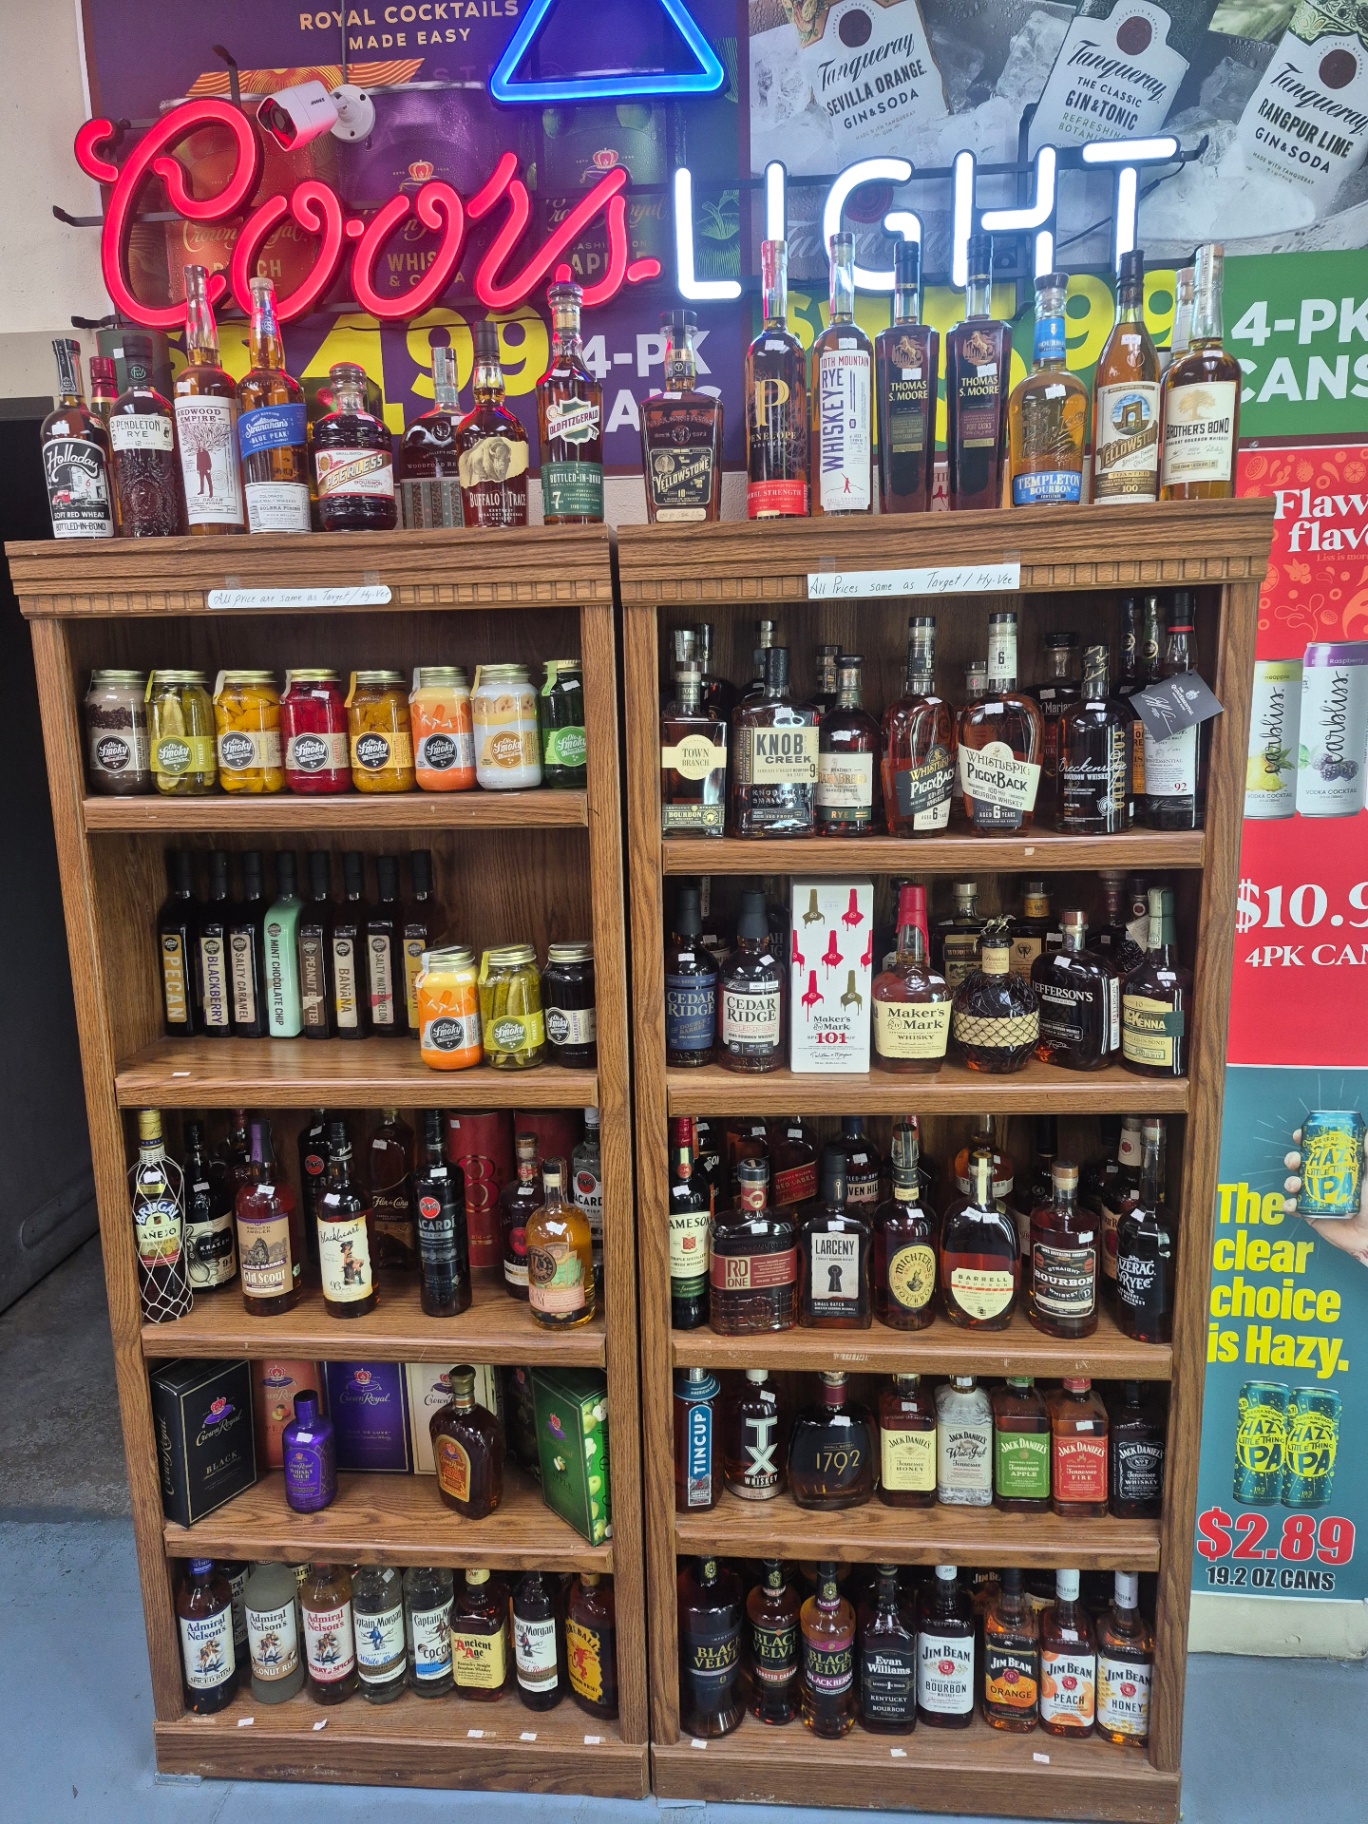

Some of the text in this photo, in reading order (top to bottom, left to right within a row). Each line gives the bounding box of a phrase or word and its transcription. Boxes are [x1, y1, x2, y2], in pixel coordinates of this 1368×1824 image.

[300, 0, 519, 30] ROYAL COCKTAILS
[349, 28, 471, 50] MADE EASY
[817, 34, 914, 91] Tanqueray
[826, 82, 874, 117] SEVILLA
[1078, 76, 1142, 108] THE CLASSIC
[843, 88, 919, 129] GIN&SODA
[1065, 90, 1138, 131] GIN&TONIC
[1258, 98, 1354, 159] RANGPUR LIME
[1255, 127, 1330, 174] GIN&SODA
[74, 97, 1180, 328] Coors LIGHT
[838, 356, 869, 368] MOUNTAIN
[822, 368, 844, 389] RYE
[891, 380, 927, 392] THOMAS
[961, 375, 998, 386] THOMAS
[889, 390, 928, 402] S. MOORE
[959, 385, 999, 397] S. MOORE
[117, 420, 160, 431] PENDLETON
[245, 419, 288, 438] Stranahan's
[550, 410, 598, 435] OLD FITZGERALD
[1166, 418, 1229, 440] BROTHER'S BOND
[251, 435, 266, 443] BLUE
[822, 390, 845, 474] WHISKEY
[46, 444, 98, 483] Holladay
[327, 454, 382, 488] PEERLESS
[652, 458, 710, 494] YELLOWSTONE
[1018, 474, 1080, 489] TEMPLETON
[1030, 485, 1071, 494] BOURBON
[1122, 484, 1138, 492] 100
[470, 491, 526, 507] BUFFALO TRACE
[1287, 520, 1368, 552] flav
[810, 577, 826, 595] All
[832, 575, 858, 594] Prices
[870, 583, 892, 591] same
[903, 581, 914, 590] as
[927, 571, 962, 591] Target
[280, 594, 301, 603] same
[323, 590, 350, 603] Target
[682, 748, 709, 758] TOWN
[756, 733, 804, 756] KNOB
[682, 759, 709, 767] BRANCH
[765, 756, 811, 764] CREEK
[1245, 946, 1305, 967] 4PK
[270, 939, 284, 1026] MINT CHOCOLATE CHIP
[305, 956, 317, 994] PEANUT
[164, 956, 184, 1020] PECAN
[207, 956, 223, 1024] BLACKBERRY
[338, 968, 352, 1013] BANANA
[1032, 980, 1094, 1002] JEFFERSON'S
[236, 980, 249, 1020] CARAMEL
[727, 996, 776, 1010] CEDAR
[727, 1008, 776, 1022] RIDGE
[888, 1007, 945, 1018] Maker's
[433, 1026, 461, 1038] Smoky
[903, 1019, 944, 1030] Mark
[815, 1032, 848, 1044] 101
[1217, 1182, 1285, 1225] The
[136, 1201, 179, 1225] BRUGAL
[200, 1239, 229, 1251] KRAKEN
[815, 1239, 854, 1255] LARCENY
[1213, 1230, 1314, 1273] clear
[726, 1259, 748, 1278] RD
[727, 1277, 748, 1288] ONE
[958, 1274, 1008, 1283] BARRELL
[1210, 1276, 1340, 1323] choice
[1207, 1323, 1349, 1380] is Hazy.
[1241, 1420, 1283, 1435] HAZY
[693, 1414, 707, 1475] TINCUP
[889, 1435, 931, 1449] JACK DANIEL'S
[1058, 1442, 1105, 1457] JACK DANIEL'S
[206, 1450, 238, 1473] BLACK
[816, 1450, 860, 1476] 1792
[744, 1474, 778, 1486] WHISKEY
[1197, 1506, 1355, 1565] $2.89
[1206, 1566, 1335, 1591] 19.2 OZ CANS
[187, 1613, 225, 1632] Admiral
[307, 1612, 344, 1623] Admiral
[308, 1621, 344, 1631] Nelson's
[187, 1625, 226, 1641] Nelson's
[454, 1638, 492, 1650] Ancient
[462, 1648, 484, 1659] Age
[875, 1656, 902, 1666] Evan
[922, 1644, 970, 1662] JIM BEAM
[867, 1663, 911, 1675] Williams
[990, 1657, 1032, 1674] JIM BEAM
[1048, 1663, 1092, 1678] JIM BEAM
[925, 1681, 966, 1693] BOURBON
[990, 1686, 1032, 1699] ORANGE
[1054, 1692, 1085, 1705] PEACH
[1111, 1699, 1143, 1713] HONEY
